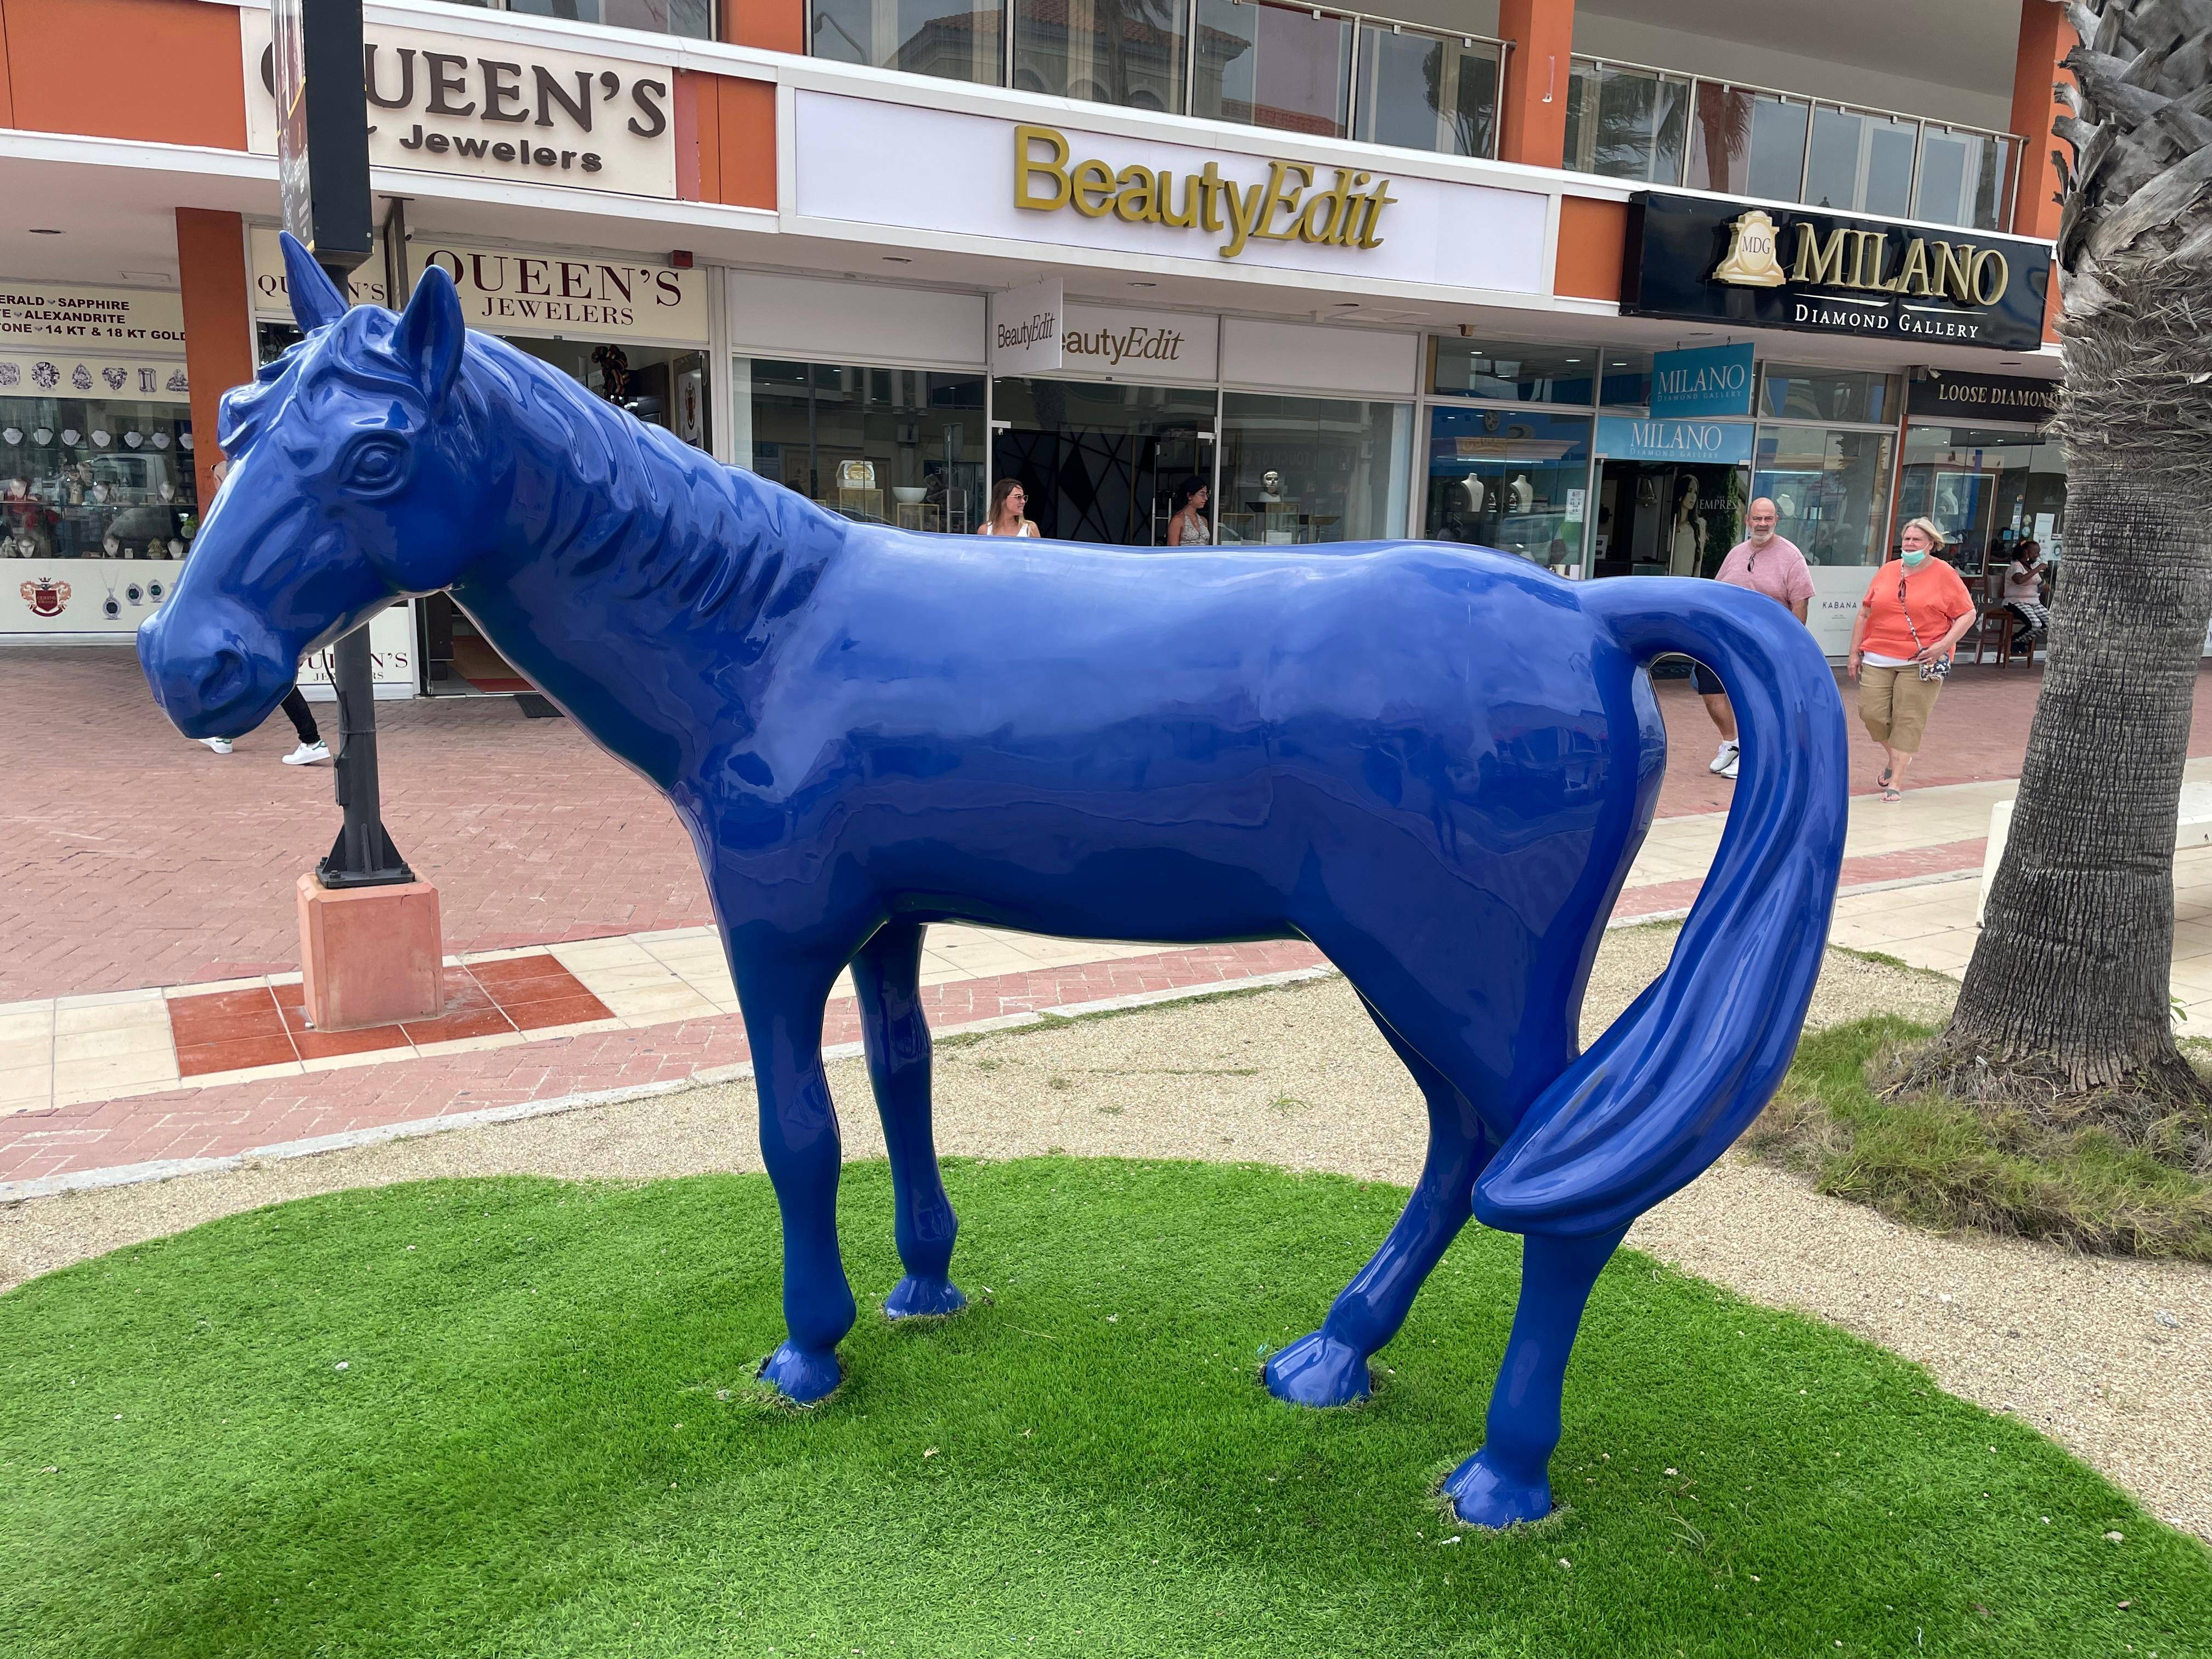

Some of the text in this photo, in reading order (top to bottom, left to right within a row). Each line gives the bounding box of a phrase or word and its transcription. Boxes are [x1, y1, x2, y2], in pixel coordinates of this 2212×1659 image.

[261, 41, 666, 138] UEEN'S
[399, 124, 602, 172] Jewelers
[1014, 125, 1398, 258] BeautyEdit
[1742, 236, 1770, 254] MDG
[1789, 222, 2008, 306] MILANO
[25, 310, 126, 324] ALEXANDRITE
[58, 298, 129, 311] SAPPHIRE
[482, 297, 634, 325] JEWELERS
[0, 323, 32, 332] ONE
[46, 325, 63, 334] 14
[67, 325, 86, 336] KT
[91, 327, 101, 336] &
[106, 328, 123, 338] 18
[127, 329, 146, 338] KT
[998, 312, 1056, 351] BeautyEdit
[1795, 304, 1979, 338] DIAMOND GALLERY
[1658, 364, 1745, 394] MILANO
[1657, 393, 1699, 402] DIAMOND
[1938, 384, 1988, 403] LOOSE
[1630, 422, 1722, 451] MILANO
[1629, 448, 1674, 458] DIAMOND
